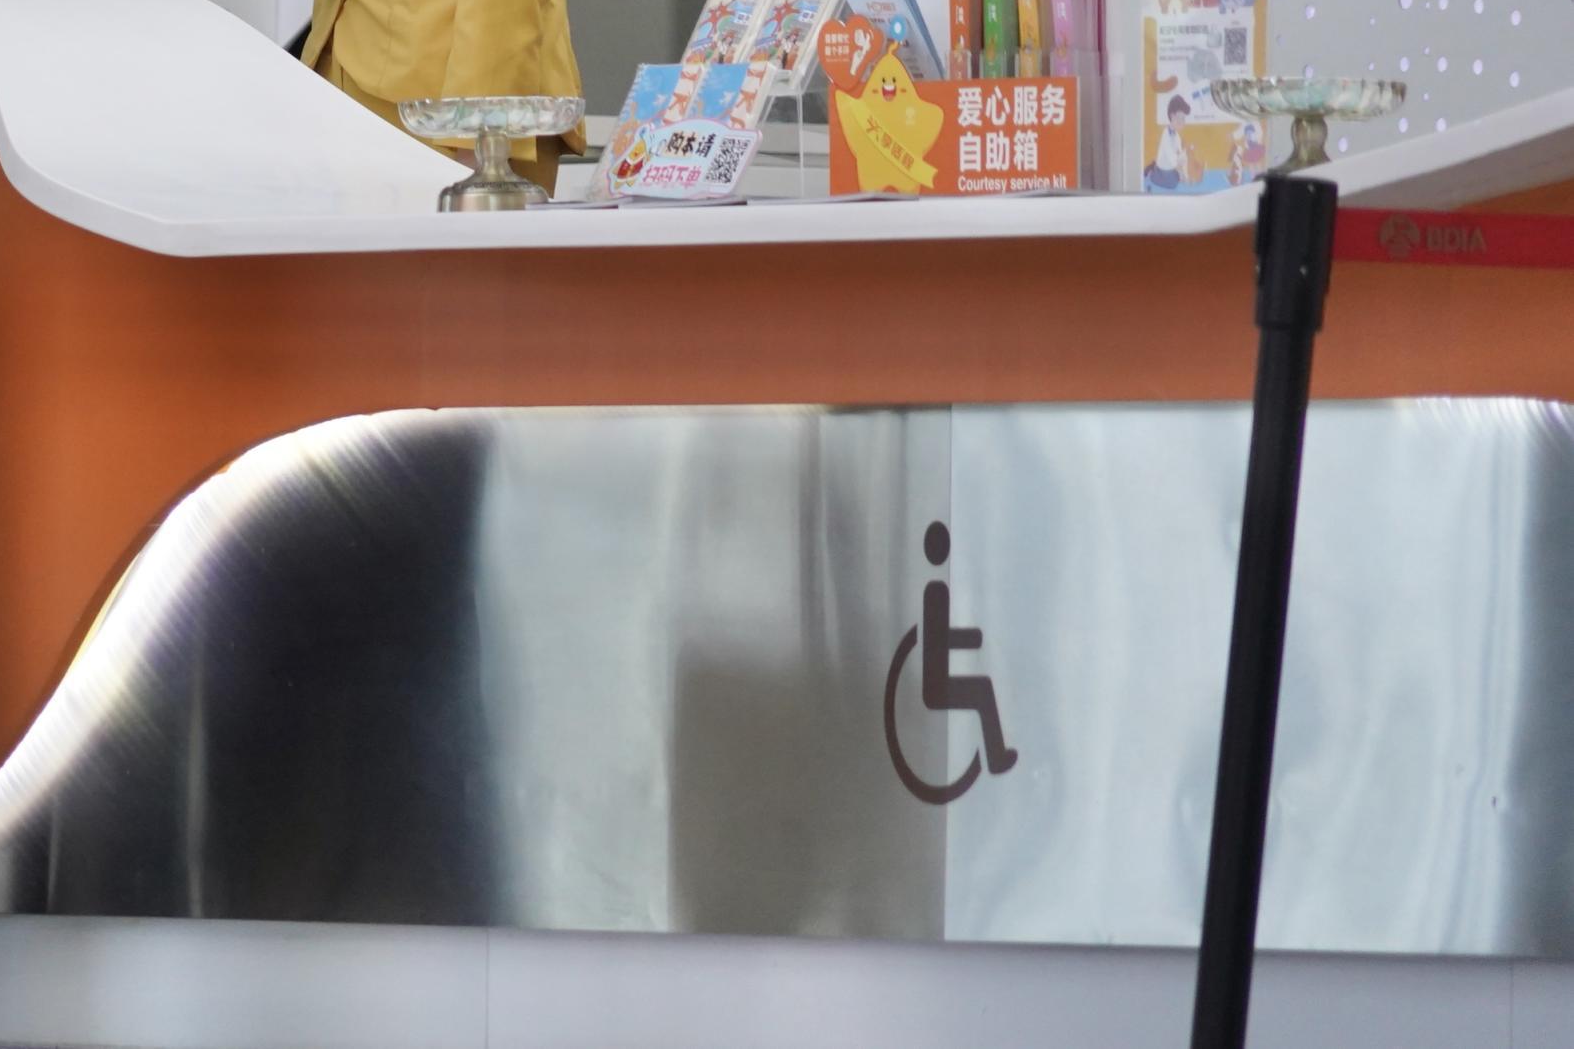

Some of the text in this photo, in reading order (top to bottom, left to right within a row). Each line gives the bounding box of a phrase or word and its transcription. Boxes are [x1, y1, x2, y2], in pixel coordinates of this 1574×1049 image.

[957, 83, 1067, 127] 爱心服务
[958, 129, 1039, 172] 自助箱
[957, 173, 1067, 194] Courtesy service kit
